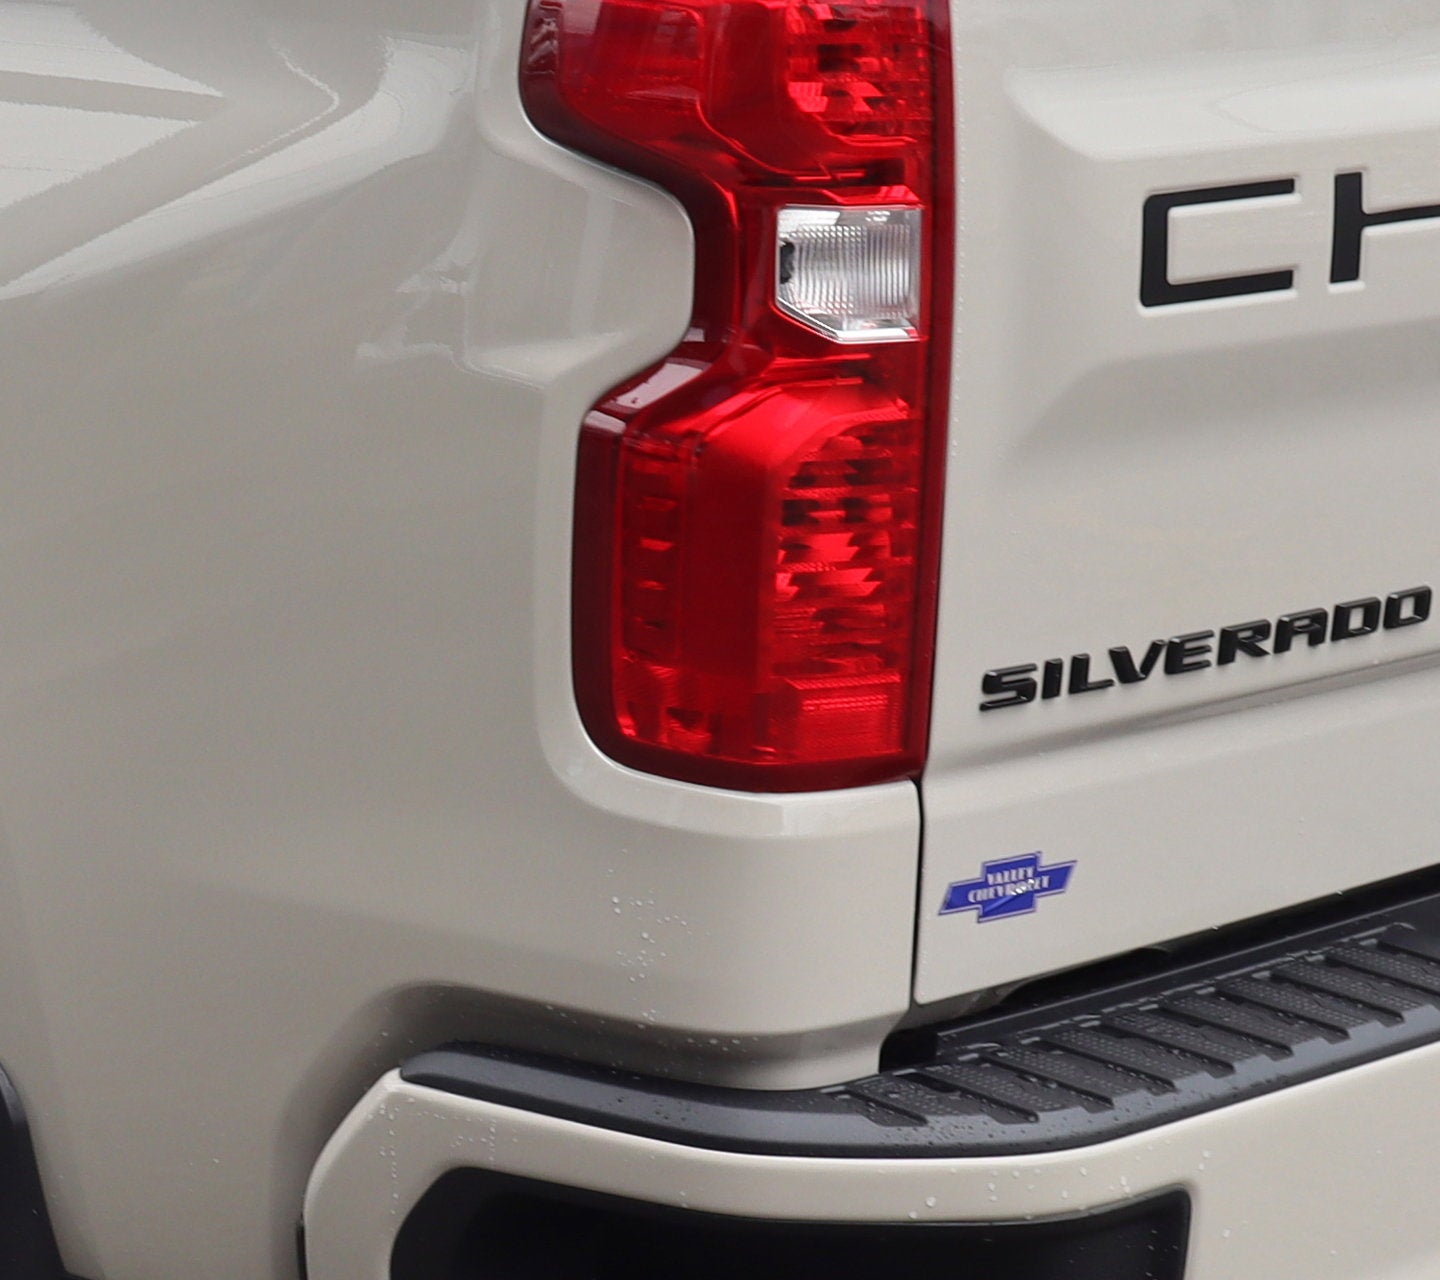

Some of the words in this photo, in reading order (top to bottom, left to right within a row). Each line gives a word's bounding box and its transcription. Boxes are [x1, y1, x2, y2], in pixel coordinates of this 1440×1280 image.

[979, 584, 1432, 712] SILVERADO
[968, 875, 1049, 903] CHEVROLET
[987, 866, 1035, 885] VALLEY
